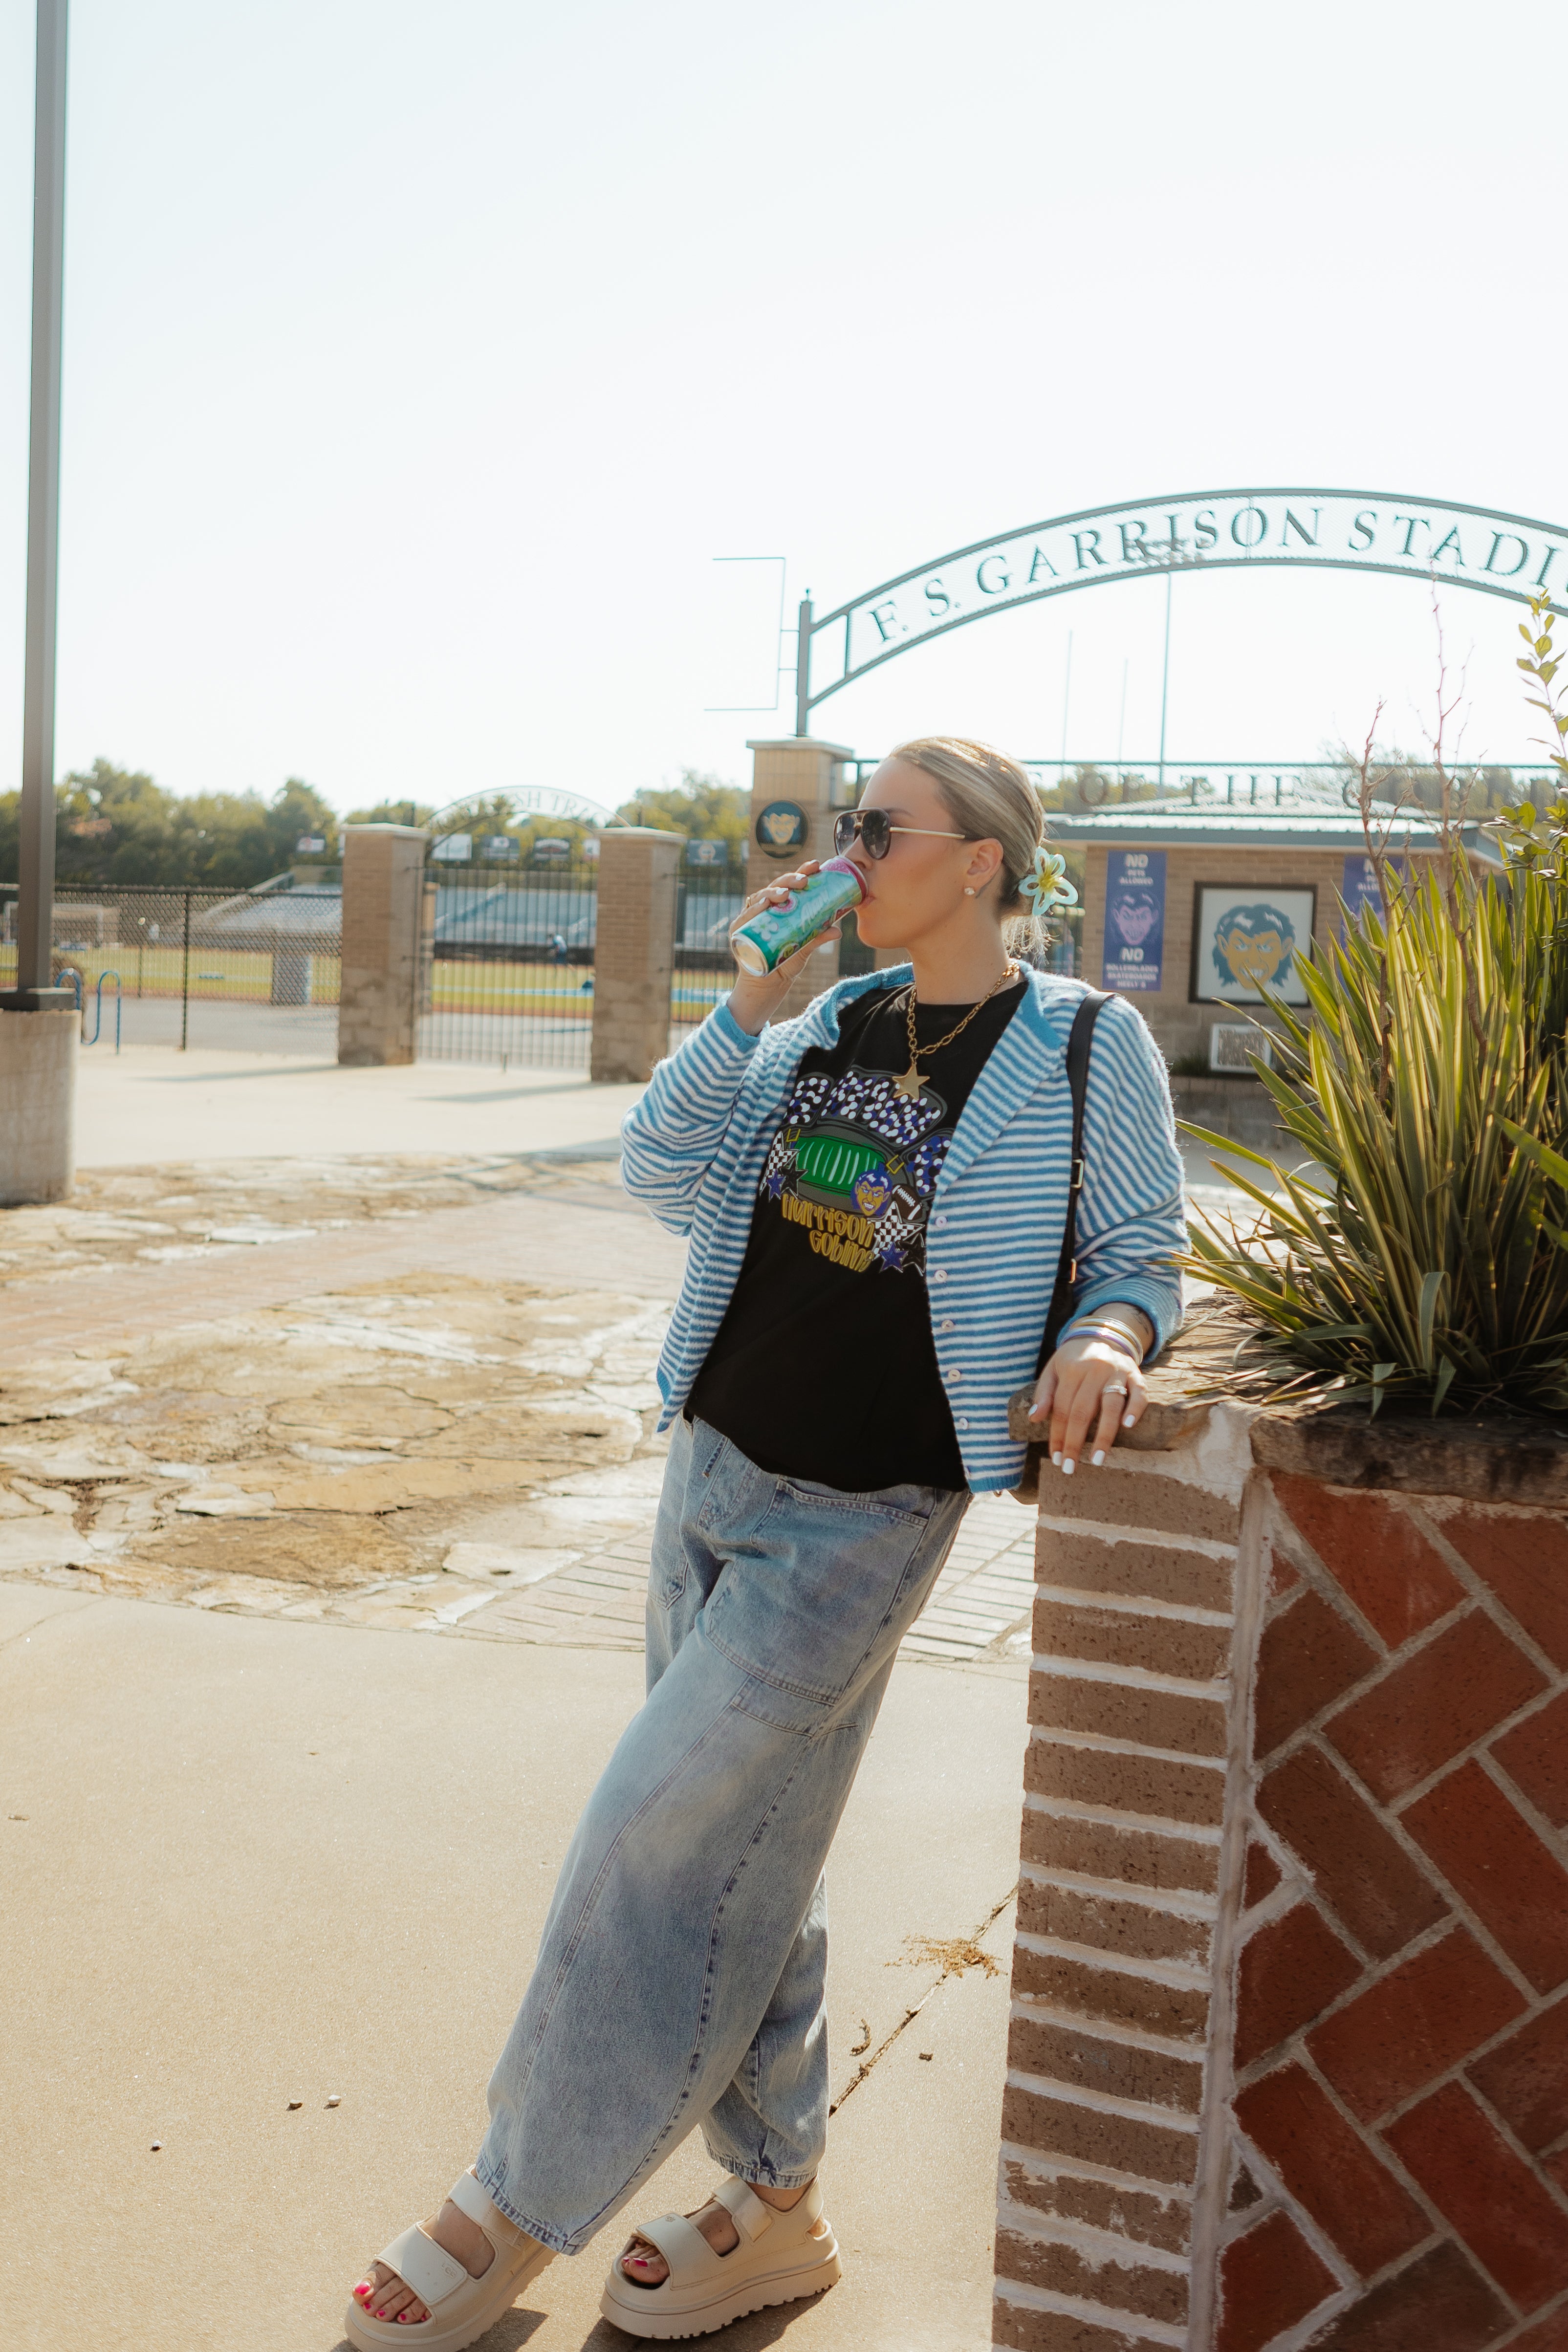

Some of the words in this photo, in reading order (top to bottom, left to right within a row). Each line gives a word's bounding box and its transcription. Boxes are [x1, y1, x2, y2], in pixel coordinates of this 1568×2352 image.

[869, 600, 909, 644] F.
[924, 578, 961, 617] S.
[977, 507, 1324, 594] GARRISON
[1348, 509, 1568, 589] STADI
[1125, 853, 1148, 868] NO
[1119, 876, 1153, 885] ALLOWED
[1121, 947, 1144, 961] NO
[782, 1193, 875, 1248] Harrison
